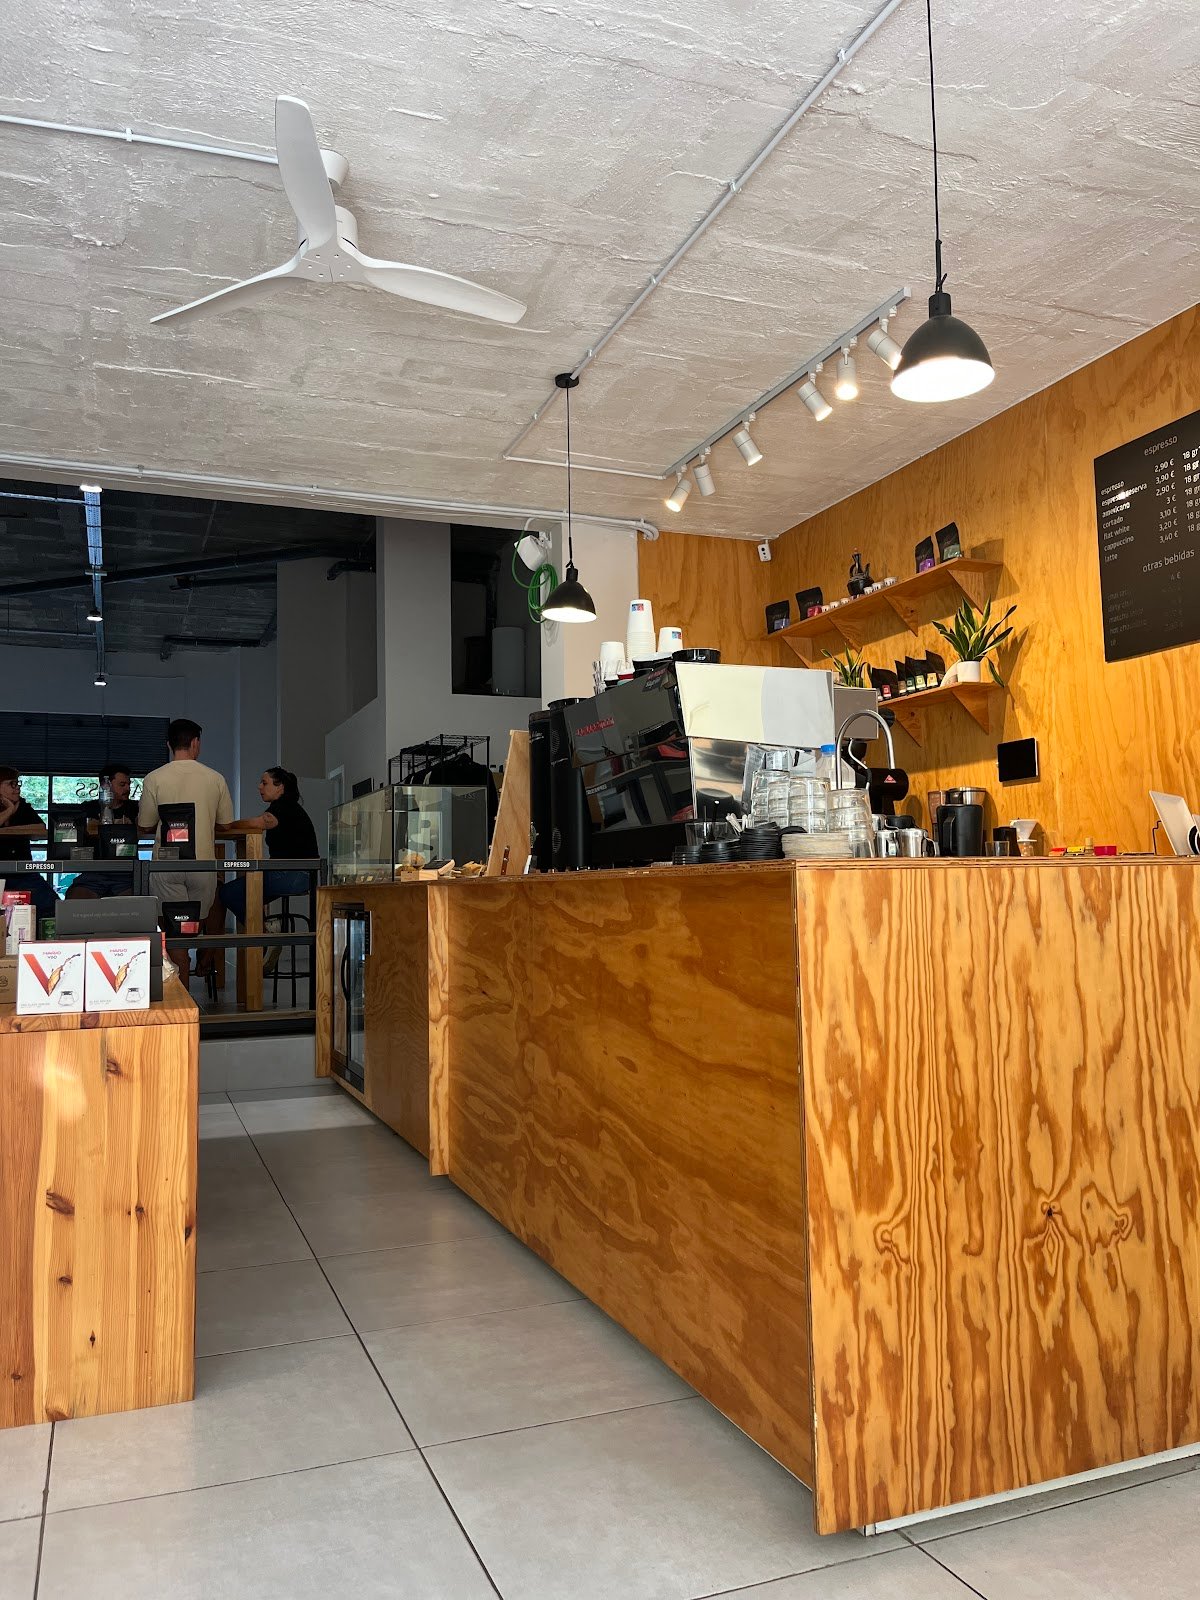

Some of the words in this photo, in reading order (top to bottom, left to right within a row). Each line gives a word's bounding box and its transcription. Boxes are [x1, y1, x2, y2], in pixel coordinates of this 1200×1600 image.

[1144, 435, 1178, 456] espresso
[1100, 480, 1125, 496] espresso
[1154, 460, 1169, 473] 2,90
[1169, 458, 1175, 466] €
[1182, 450, 1190, 459] 18
[1101, 491, 1126, 507] espres
[1155, 473, 1169, 484] 3,90
[1170, 470, 1175, 478] €
[1183, 463, 1191, 472] 18
[1101, 501, 1131, 519] americano
[1155, 485, 1170, 497] 2,90
[1171, 482, 1176, 490] €
[1184, 475, 1191, 484] 18
[1102, 516, 1124, 529] cortado
[1166, 497, 1171, 505] 3
[1172, 494, 1177, 502] €
[1185, 487, 1192, 496] 18
[1103, 531, 1114, 541] flat
[1114, 525, 1131, 537] white
[1159, 508, 1171, 519] 3,10
[1172, 506, 1177, 514] €
[1186, 499, 1193, 508] 18
[1103, 535, 1135, 552] cappuccino
[1159, 520, 1172, 531] 3,20
[1173, 518, 1178, 526] €
[1187, 511, 1194, 520] 18
[1104, 553, 1118, 563] latte
[1174, 530, 1179, 538] €
[1187, 524, 1195, 533] 18
[1142, 559, 1163, 573] otras
[1164, 549, 1195, 566] bebidas
